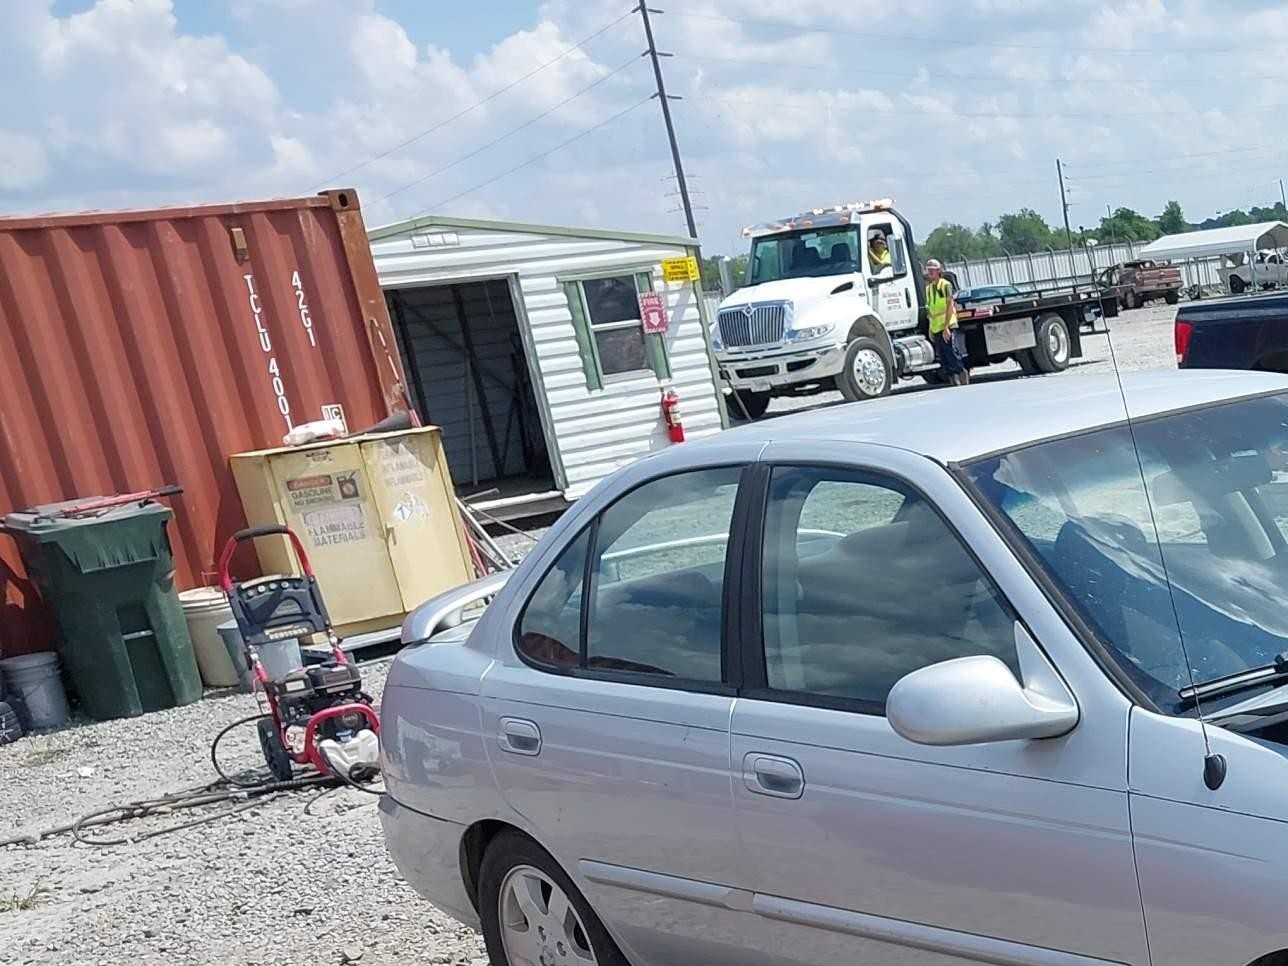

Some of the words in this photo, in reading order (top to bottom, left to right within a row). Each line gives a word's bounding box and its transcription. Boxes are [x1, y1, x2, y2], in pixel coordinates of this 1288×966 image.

[243, 274, 271, 352] TCLU
[291, 270, 316, 347] 42G1
[291, 486, 333, 501] GASOLINE
